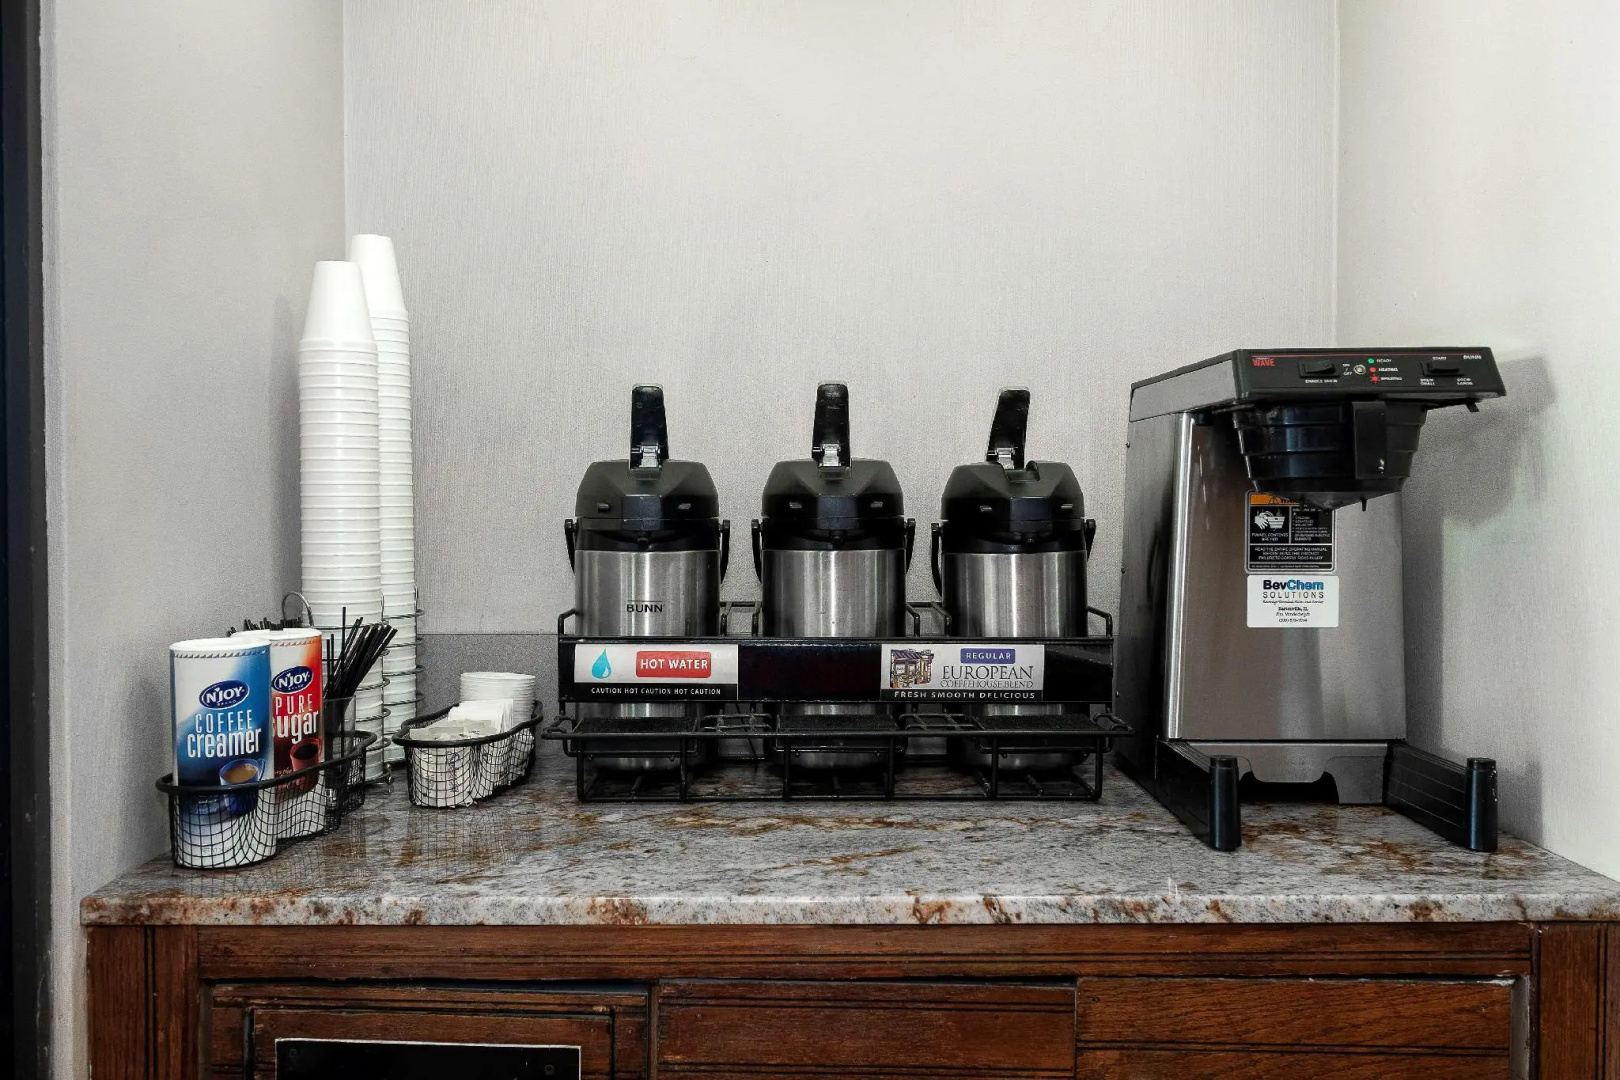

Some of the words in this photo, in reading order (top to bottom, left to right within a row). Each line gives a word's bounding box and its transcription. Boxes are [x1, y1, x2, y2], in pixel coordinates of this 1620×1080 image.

[1252, 359, 1275, 367] WAVE
[1263, 579, 1324, 590] BevChem
[1262, 591, 1325, 599] SOLUTIONS
[626, 603, 664, 613] BUNN
[965, 651, 1012, 660] REGULAR
[640, 658, 664, 670] HOT
[668, 658, 709, 670] WATER
[941, 665, 1034, 680] EUROPEAN
[940, 679, 1001, 689] COFFEEHOUSE
[1003, 679, 1034, 689] BLEND
[591, 687, 622, 695] CAUTION
[624, 687, 638, 695] HOT
[640, 687, 671, 695] CAUTION
[894, 690, 927, 698] FRESH
[931, 690, 975, 699] SMOOTH
[979, 691, 1035, 699] DELICIOUS
[275, 693, 313, 715] PURE
[195, 709, 253, 733] COFFEE
[187, 726, 262, 758] creamer
